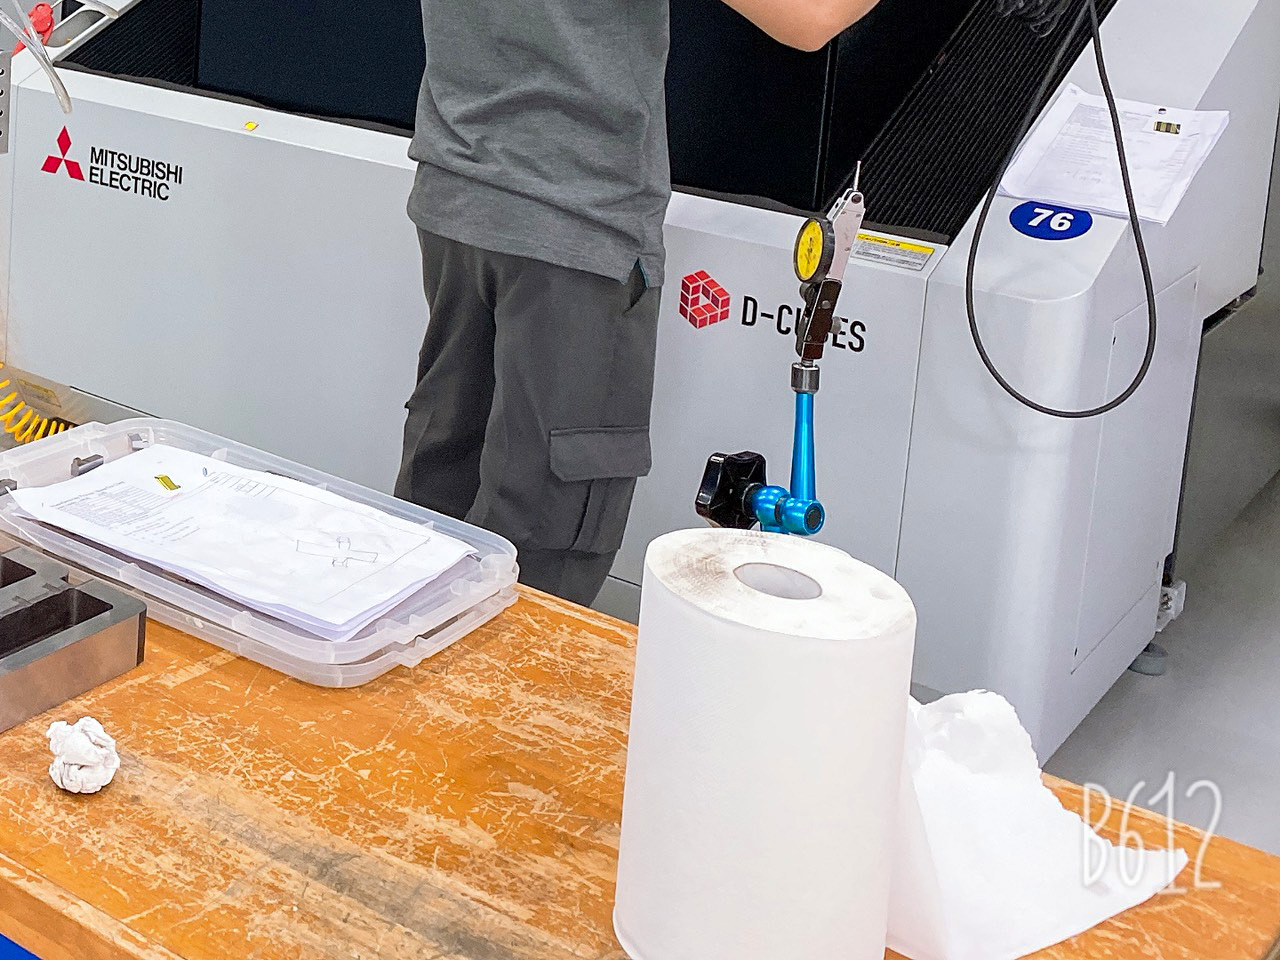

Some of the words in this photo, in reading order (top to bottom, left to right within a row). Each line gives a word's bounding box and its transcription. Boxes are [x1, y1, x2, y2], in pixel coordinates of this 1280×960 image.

[89, 166, 170, 201] ELECTRIC
[90, 146, 183, 185] MITSUBISHI
[1027, 207, 1075, 232] 76
[741, 295, 867, 353] D-CES
